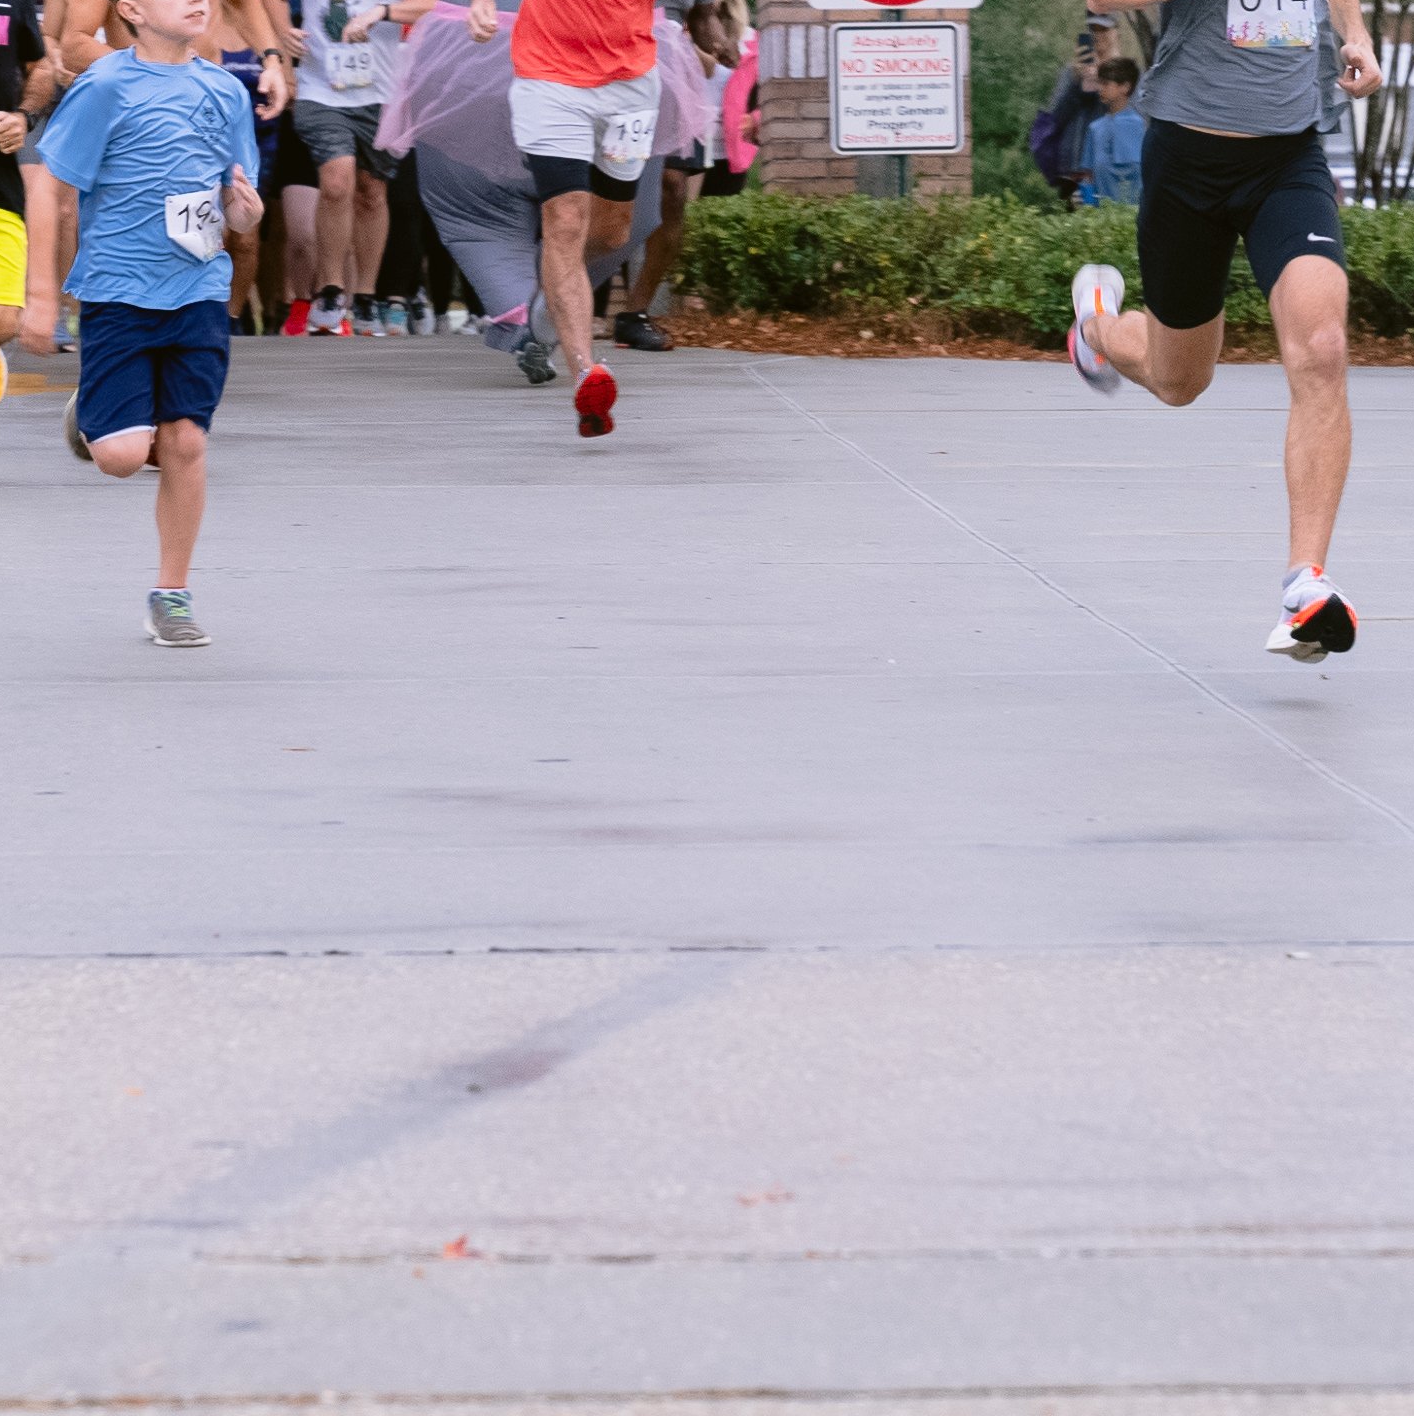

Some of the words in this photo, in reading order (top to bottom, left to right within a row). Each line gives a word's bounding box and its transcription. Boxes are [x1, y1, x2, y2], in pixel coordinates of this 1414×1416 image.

[852, 34, 936, 48] Absolutely
[333, 52, 372, 72] 149
[841, 59, 865, 73] NO
[873, 58, 951, 73] SMOKING
[896, 105, 947, 116] General
[867, 120, 924, 130] Property
